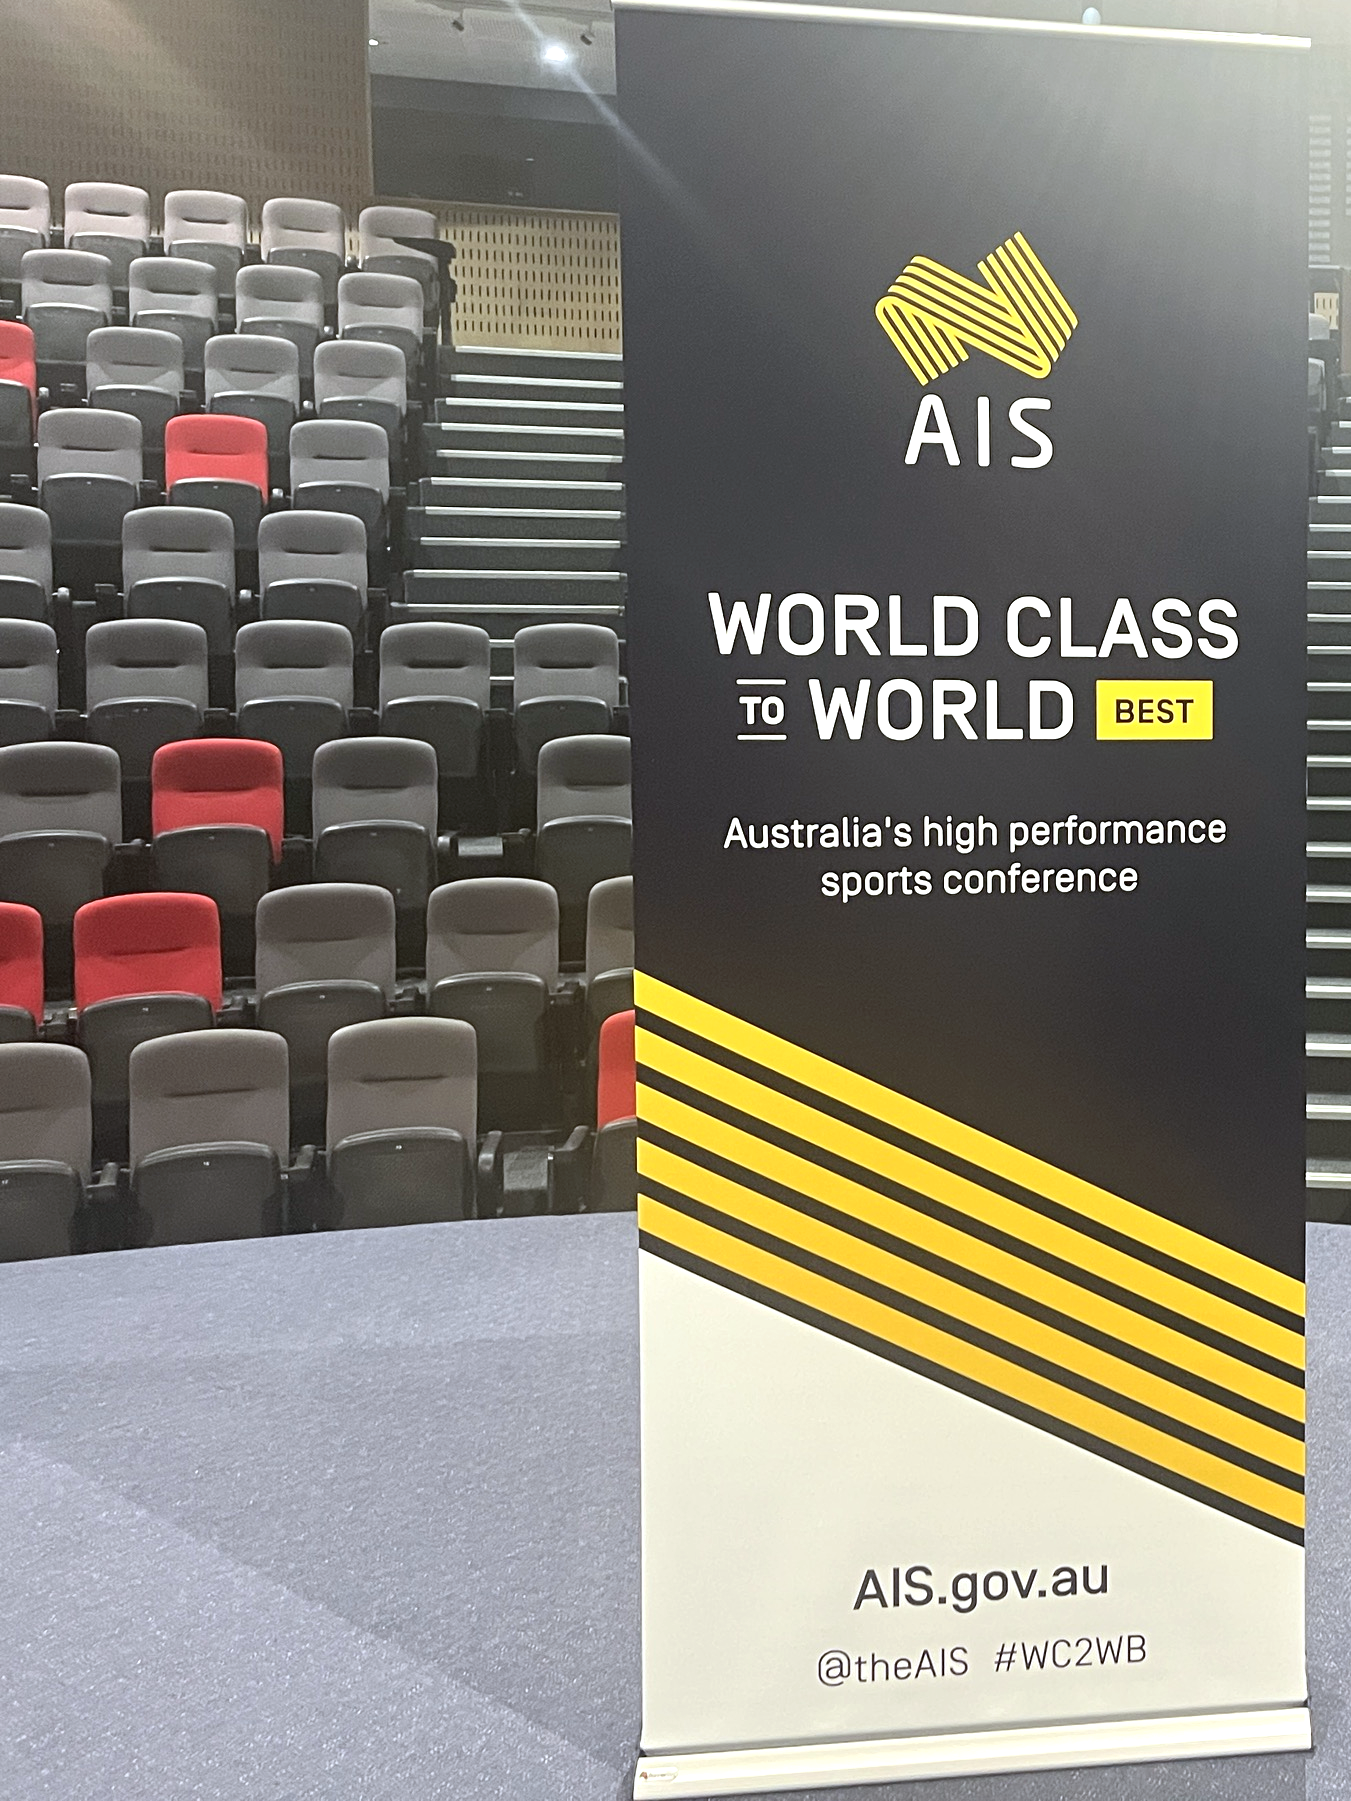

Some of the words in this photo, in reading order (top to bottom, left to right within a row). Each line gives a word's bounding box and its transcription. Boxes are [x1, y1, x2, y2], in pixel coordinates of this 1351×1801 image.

[904, 394, 1054, 470] AIS
[707, 592, 980, 657] WORLD
[1006, 596, 1239, 660] CLASS
[738, 695, 786, 725] TO
[808, 678, 1075, 741] WORLD
[1115, 698, 1195, 724] BEST
[723, 816, 913, 850] Australia's
[923, 815, 998, 854] high
[1009, 814, 1228, 853] performance
[820, 866, 933, 904] sports
[943, 862, 1139, 895] conference
[853, 1564, 1109, 1614] AIS.gov.au
[817, 1646, 970, 1688] @theAIS
[994, 1634, 1147, 1673] #WC2WB
